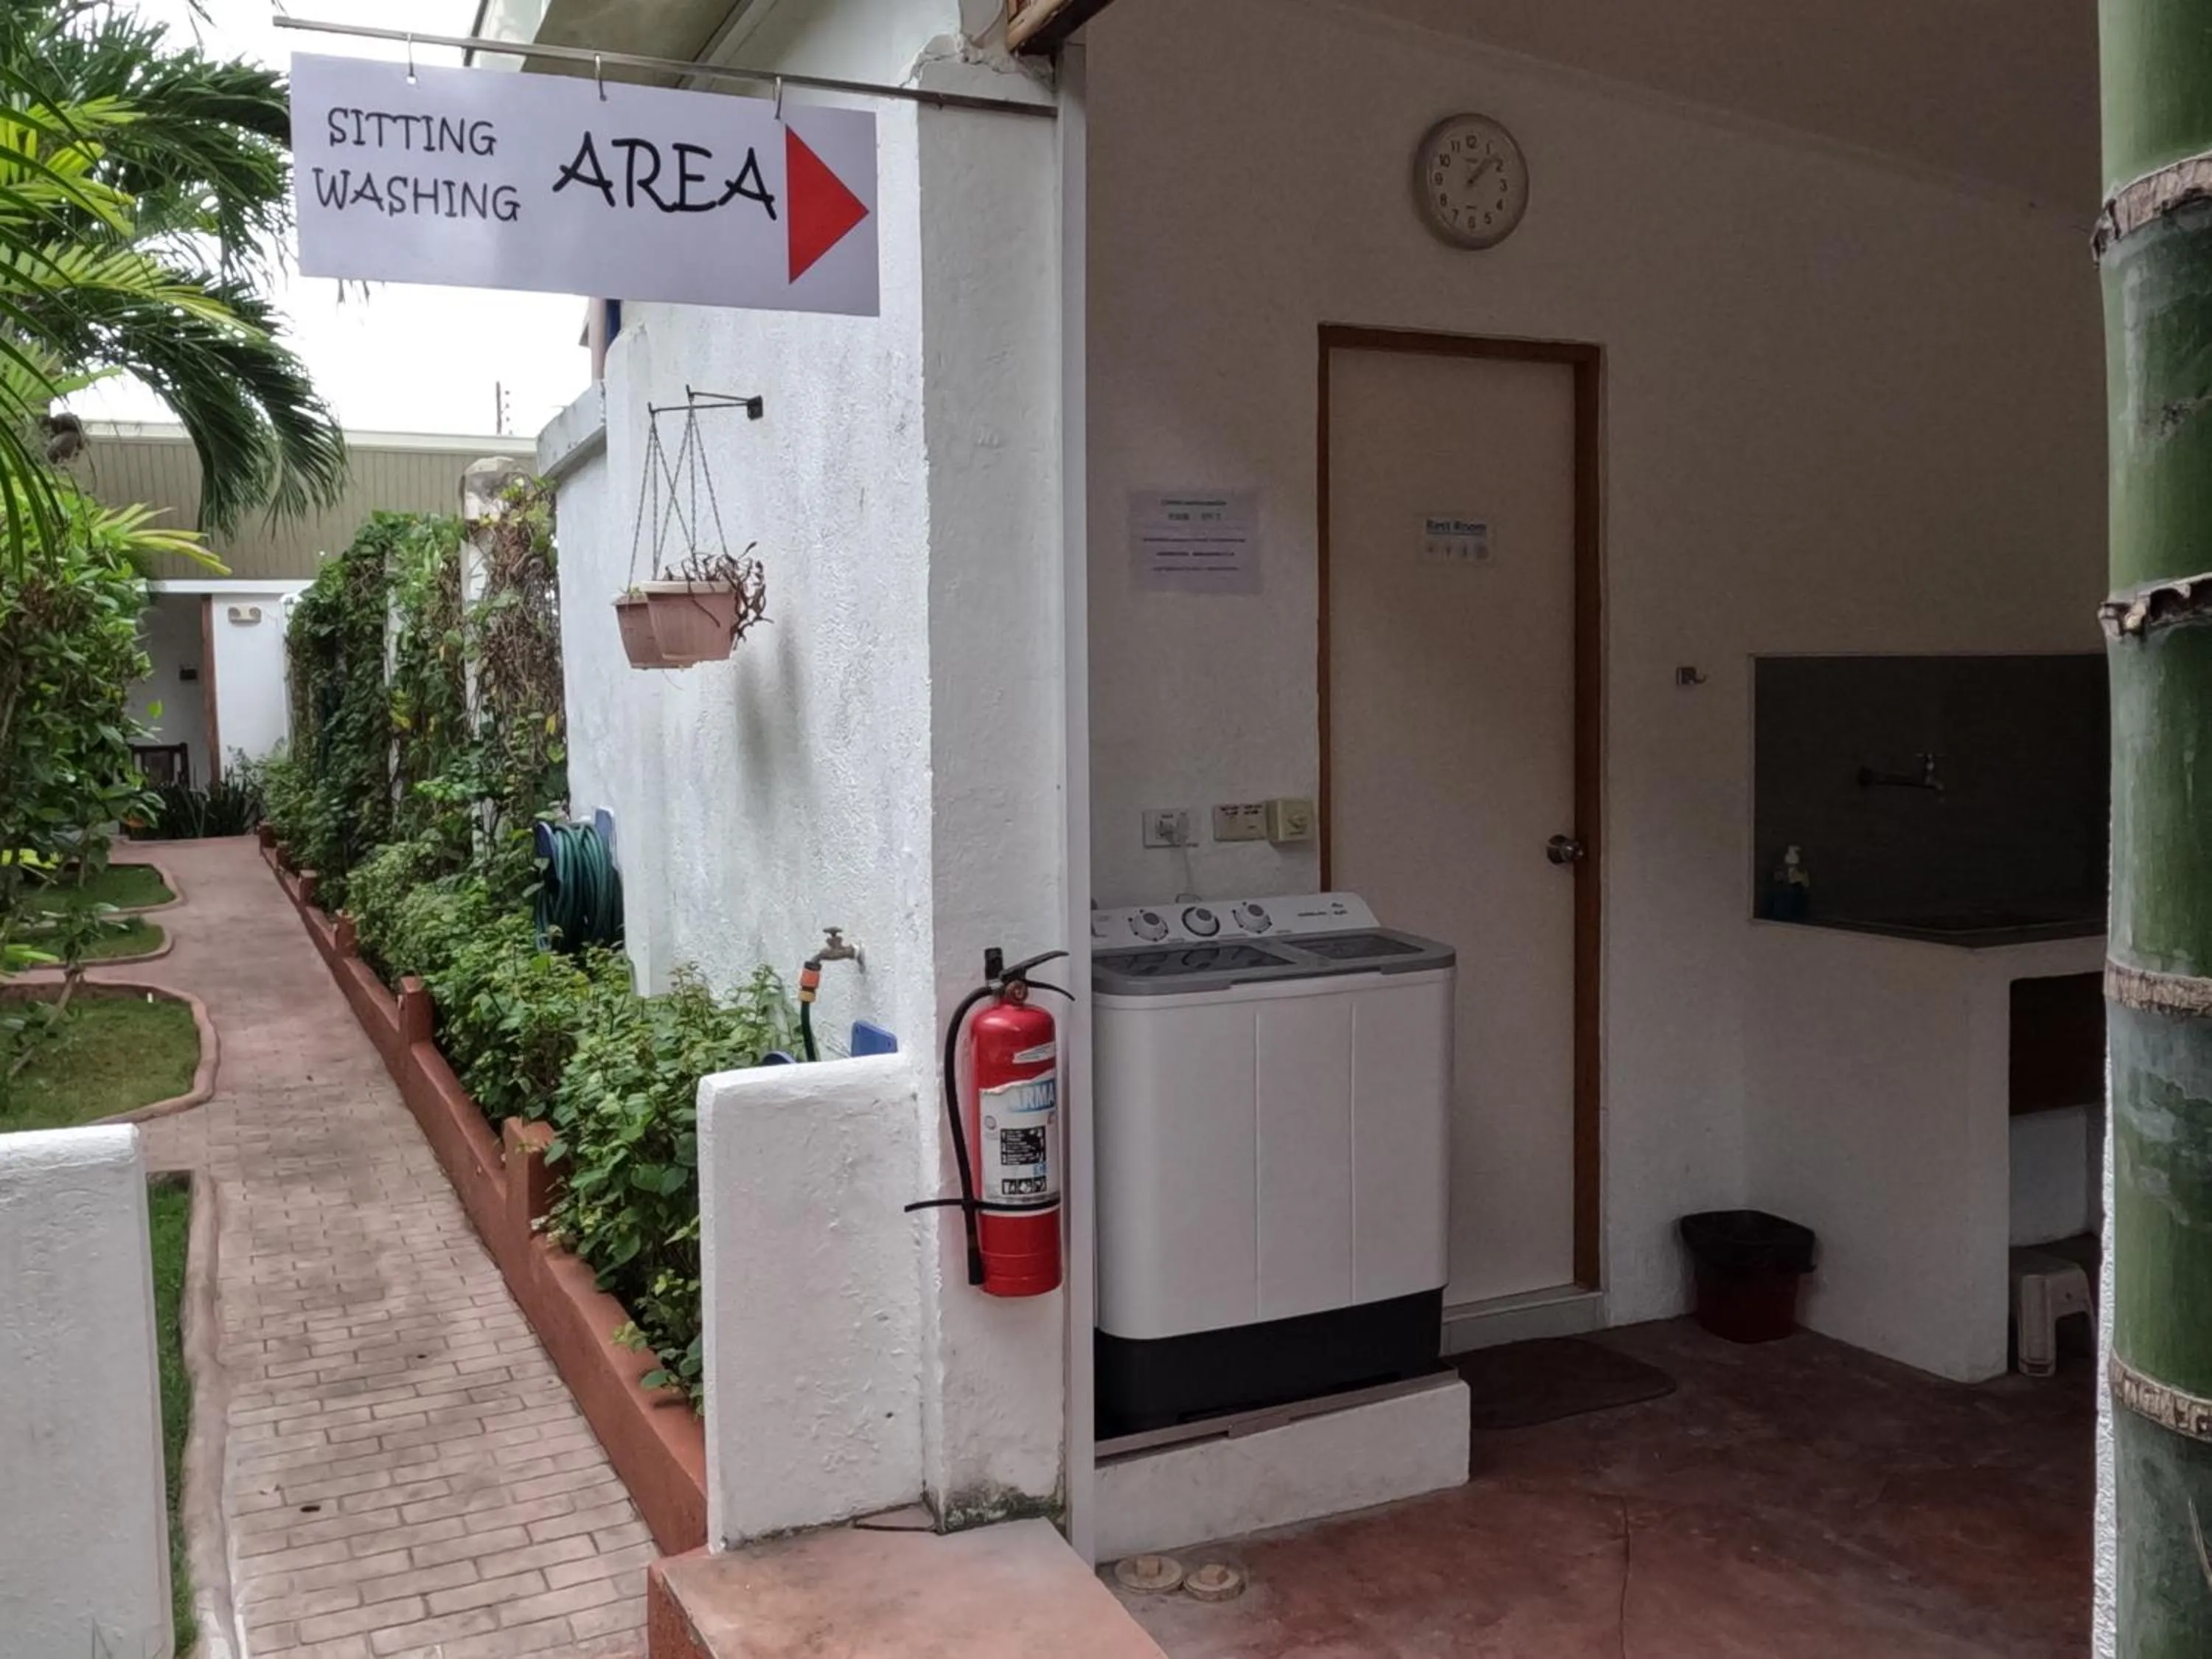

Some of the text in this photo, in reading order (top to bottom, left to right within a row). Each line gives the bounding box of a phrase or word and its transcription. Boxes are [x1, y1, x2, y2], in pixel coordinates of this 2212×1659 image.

[327, 107, 496, 156] SITTING
[552, 131, 778, 221] AREA
[1500, 178, 1508, 192] 3
[312, 167, 521, 222] WASHING
[1495, 198, 1504, 211] 4
[1451, 208, 1459, 221] 7
[1484, 212, 1492, 225] 5
